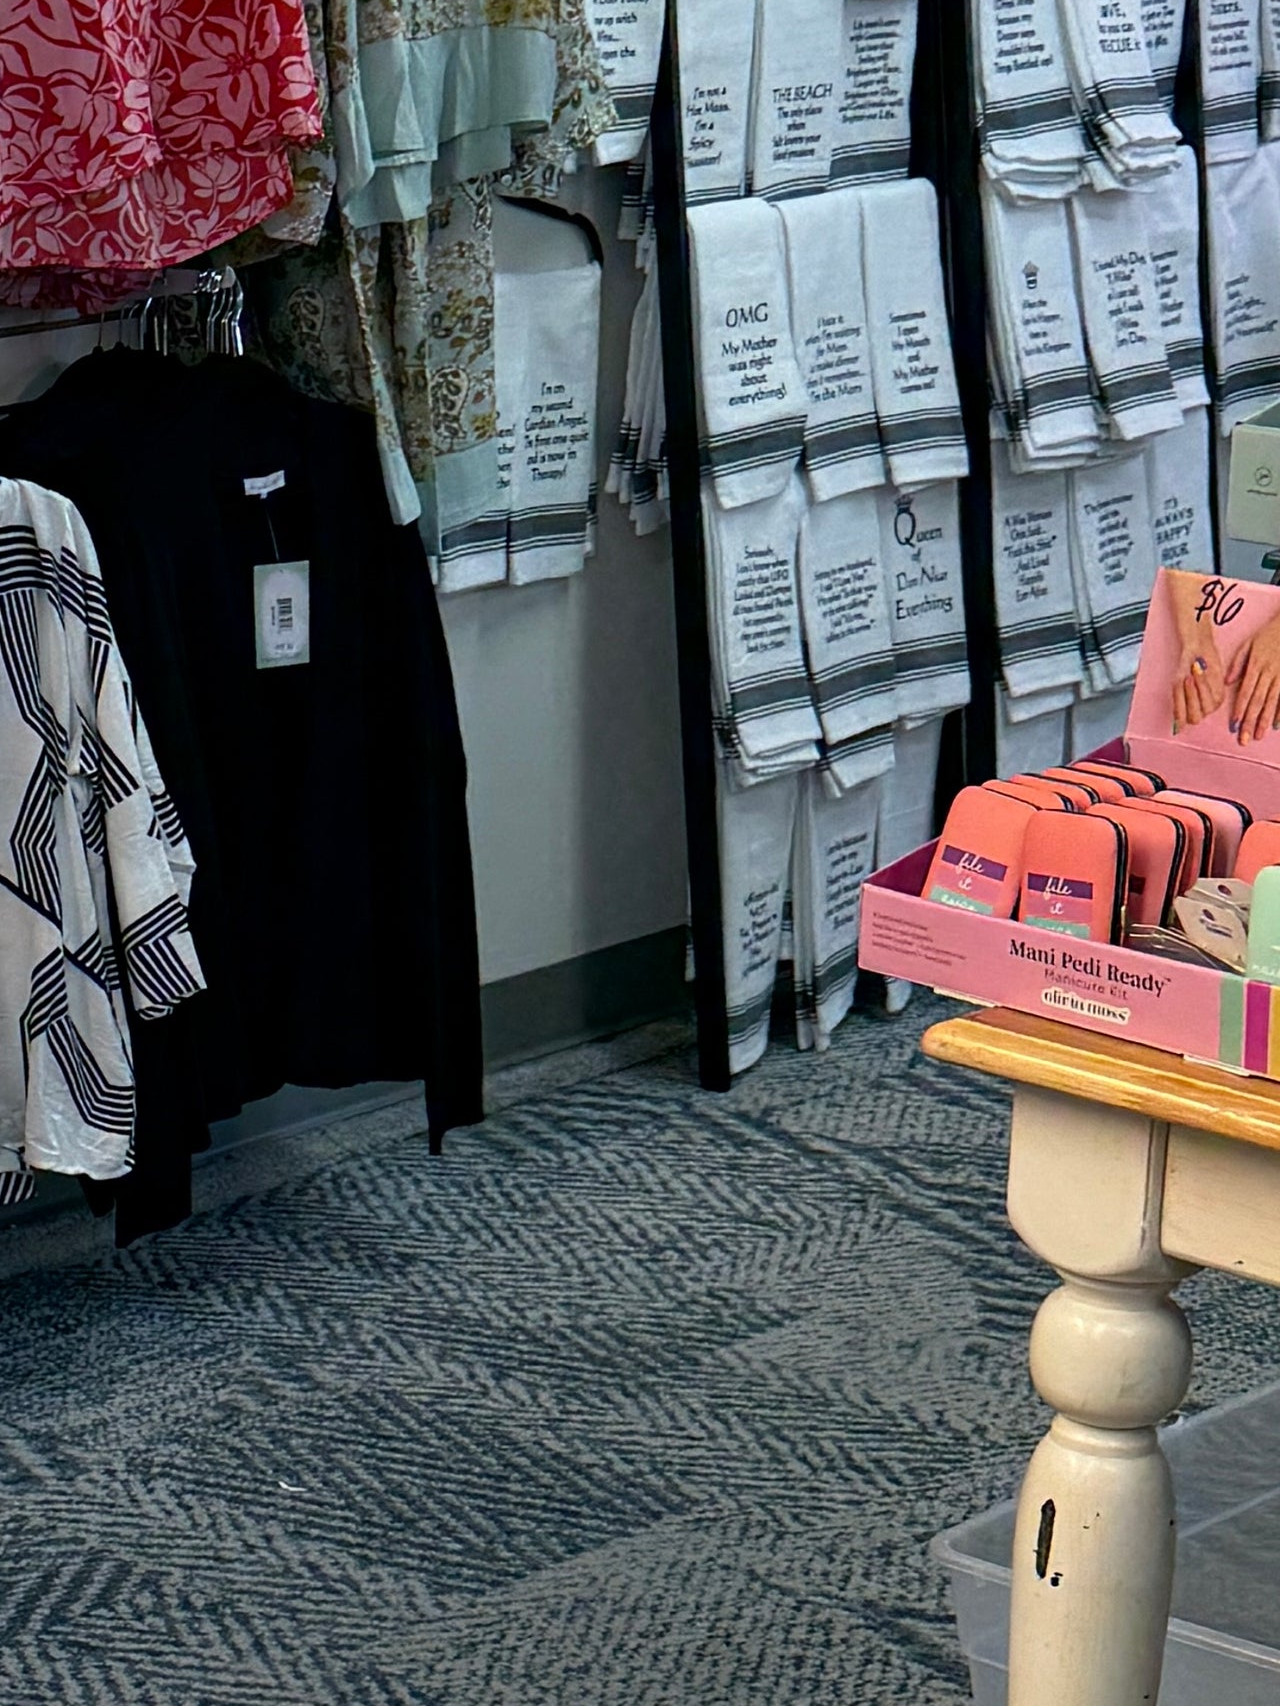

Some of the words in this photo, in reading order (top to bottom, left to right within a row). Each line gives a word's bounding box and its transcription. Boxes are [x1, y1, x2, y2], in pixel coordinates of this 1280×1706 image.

[794, 83, 834, 101] BEACH
[726, 302, 768, 328] OMG
[721, 342, 740, 358] My
[741, 335, 779, 354] Mother
[729, 361, 748, 373] was
[750, 354, 773, 371] right
[741, 373, 768, 388] about
[728, 382, 788, 407] everything!
[894, 510, 943, 548] Queen
[1195, 578, 1245, 627] $6
[955, 852, 985, 874] file
[958, 876, 973, 891] it
[1044, 876, 1072, 899] file
[1050, 901, 1065, 915] it
[1009, 938, 1055, 967] Mani
[1061, 951, 1101, 979] Pedi
[1044, 967, 1105, 994] Manicure
[1109, 986, 1129, 1001] Kit
